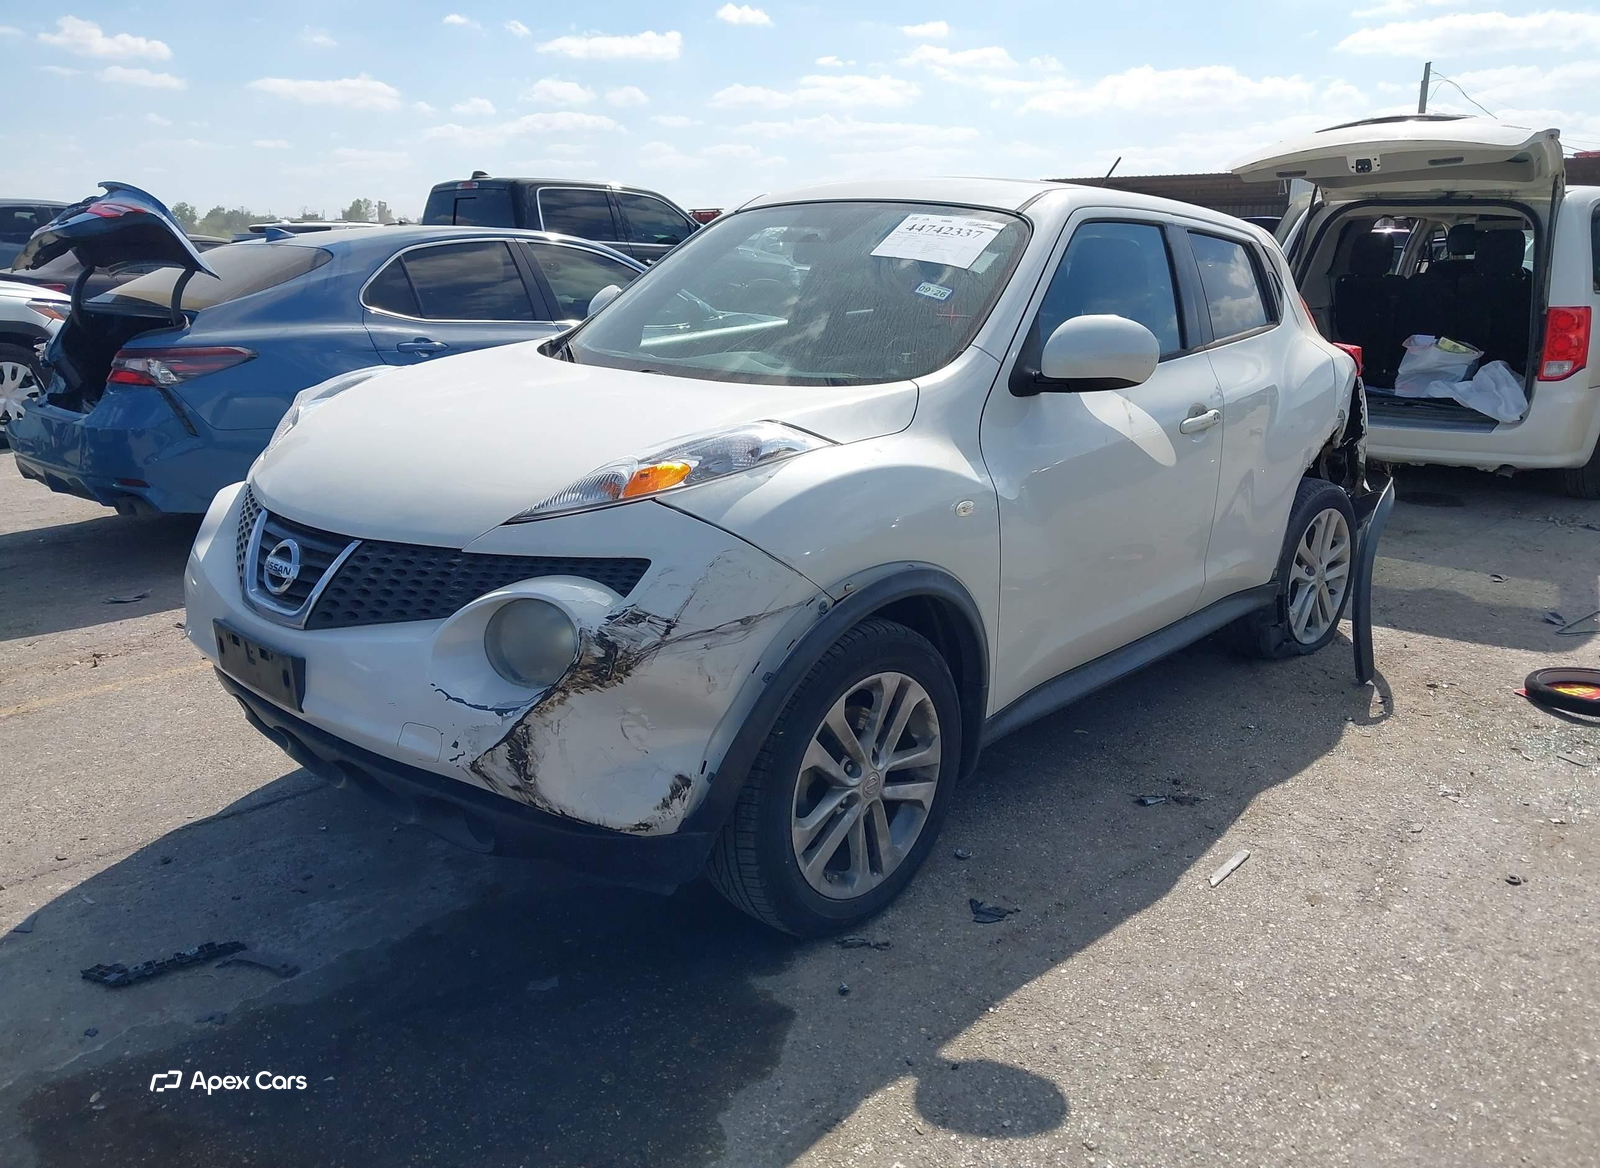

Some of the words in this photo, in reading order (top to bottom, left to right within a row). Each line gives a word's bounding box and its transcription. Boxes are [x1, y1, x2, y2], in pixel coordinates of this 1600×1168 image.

[905, 223, 984, 239] 44742337
[918, 285, 931, 293] 09
[933, 289, 948, 298] 26
[265, 558, 292, 576] SSAN
